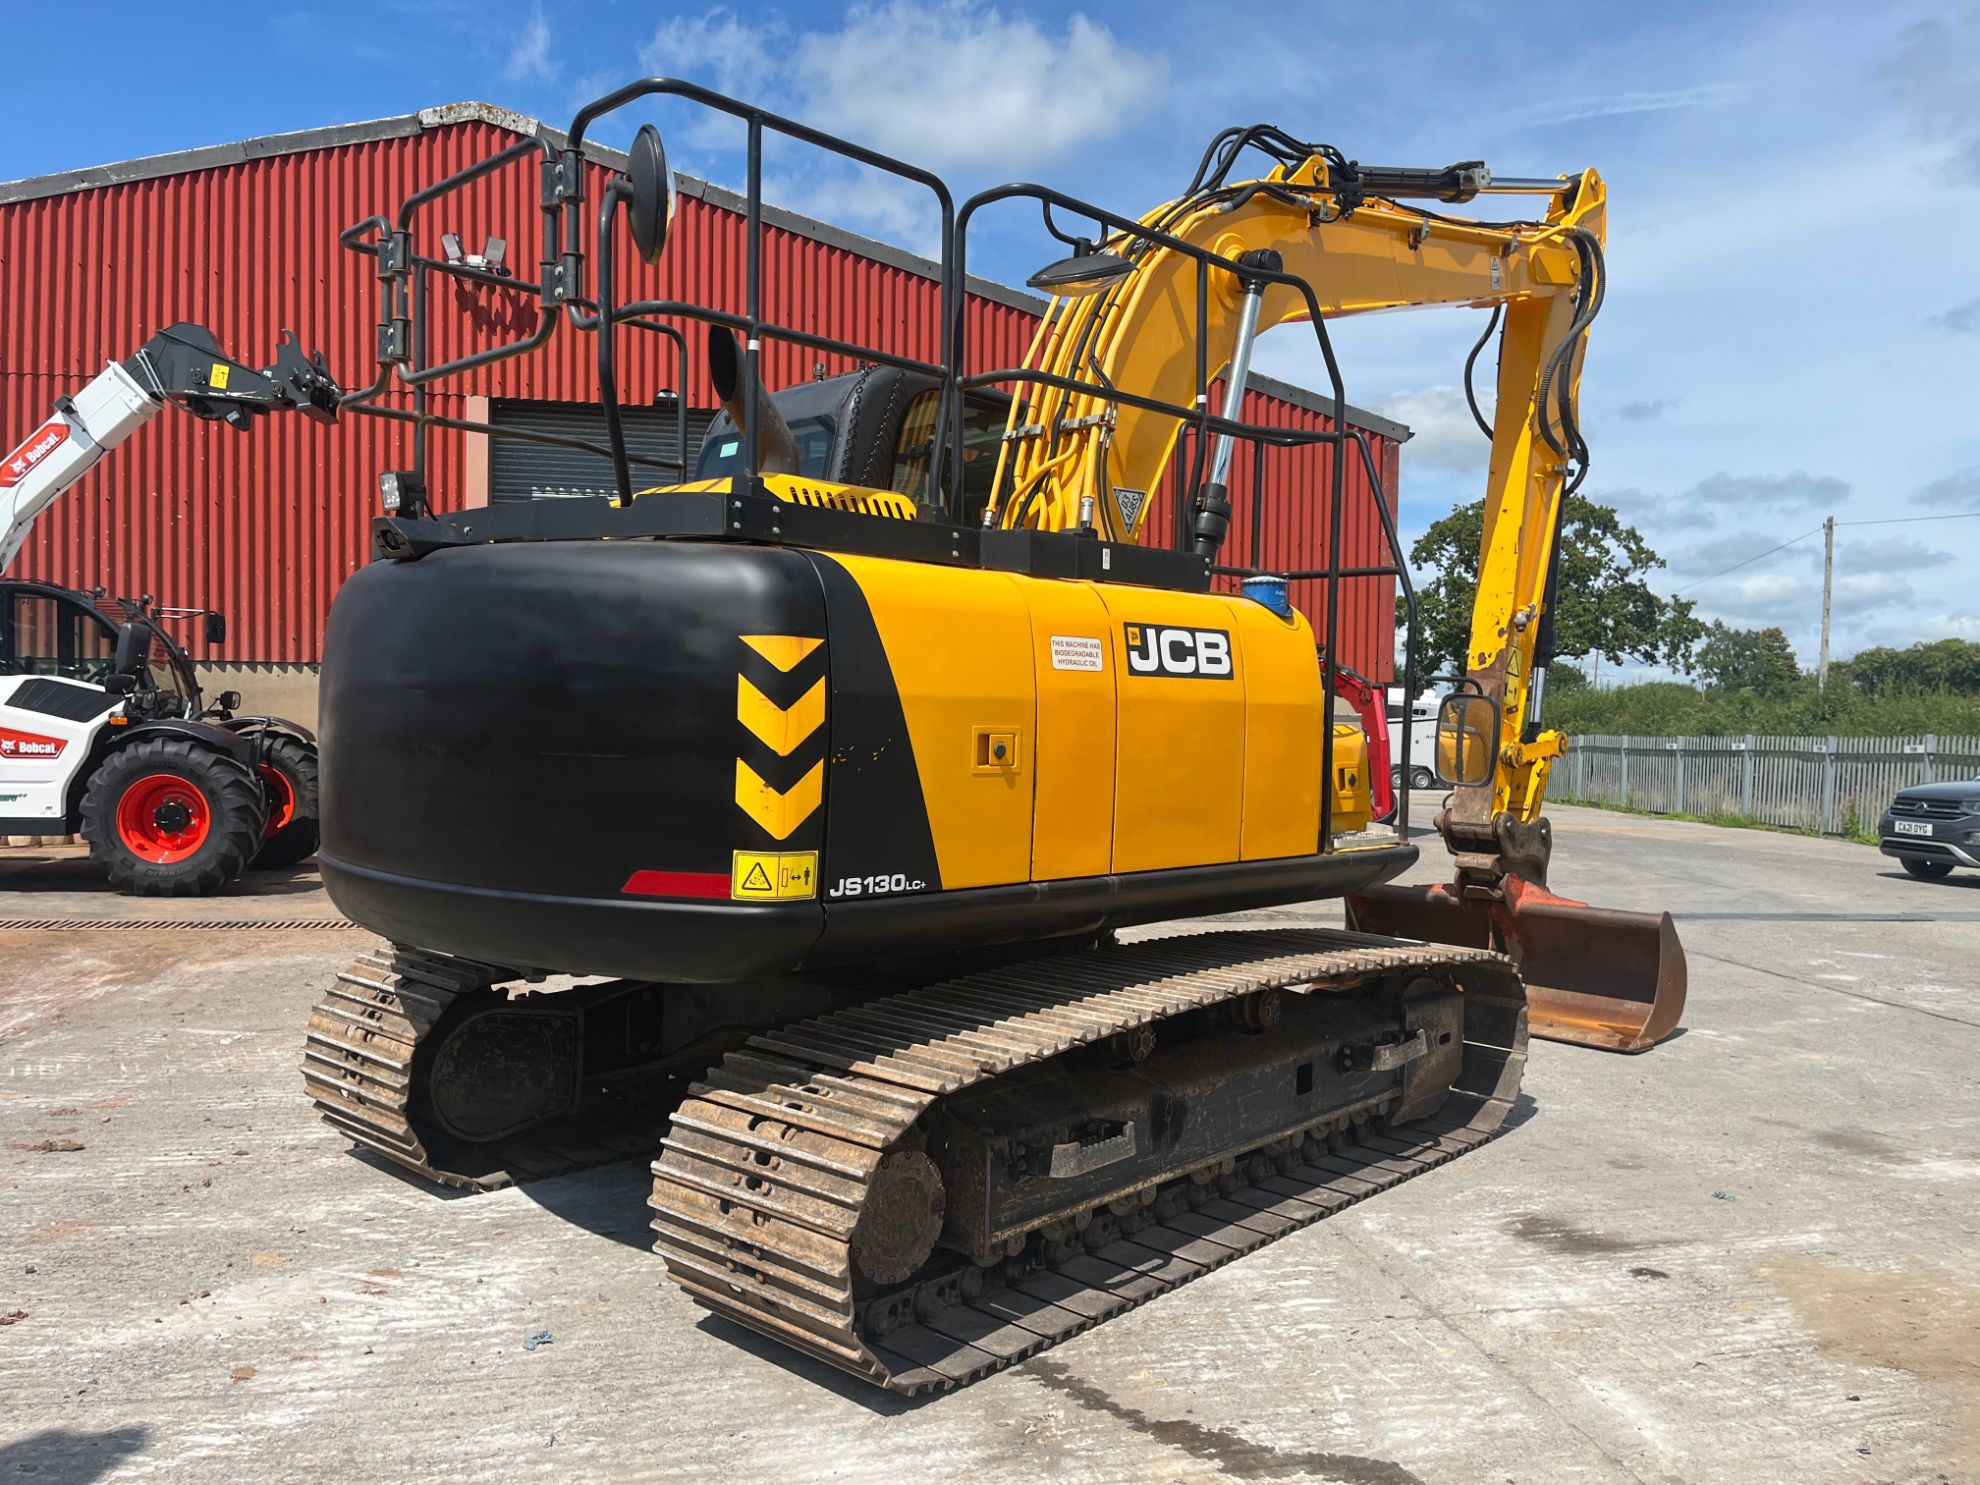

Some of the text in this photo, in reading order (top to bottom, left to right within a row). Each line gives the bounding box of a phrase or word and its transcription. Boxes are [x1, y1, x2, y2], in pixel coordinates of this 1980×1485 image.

[25, 432, 60, 463] Bobcat
[1052, 639, 1064, 647] THIS
[1065, 641, 1089, 649] MACHINE
[1055, 649, 1099, 658] BIODEGRADABLE
[1129, 628, 1231, 675] JCB
[1058, 659, 1088, 667] HYDRAULIC
[19, 741, 56, 753] Bobcat
